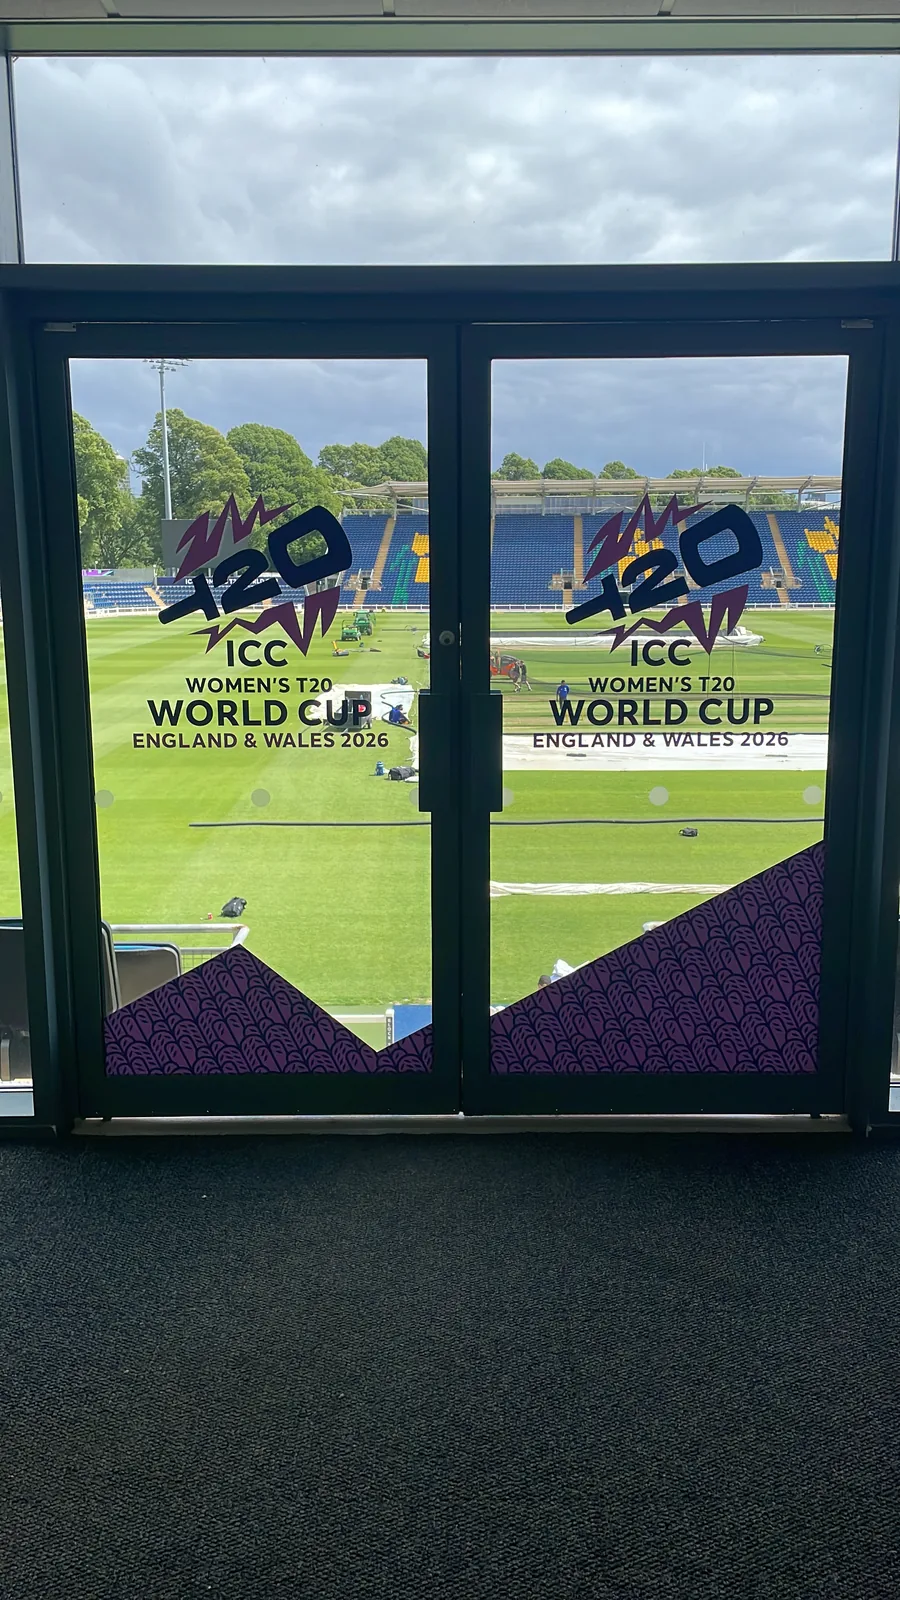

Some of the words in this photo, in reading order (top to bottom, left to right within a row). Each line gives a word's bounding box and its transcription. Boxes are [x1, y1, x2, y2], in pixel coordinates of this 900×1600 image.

[158, 505, 353, 624] T20
[565, 504, 763, 624] T20
[226, 640, 289, 667] ICC
[630, 639, 692, 667] ICC
[185, 677, 290, 693] WOMEN'S
[295, 677, 333, 693] T20
[588, 676, 692, 693] WOMEN'S
[698, 676, 736, 693] T20
[147, 699, 288, 727] WORLD
[298, 699, 373, 726] CUP
[549, 698, 688, 726] WORLD
[698, 697, 775, 725] CUP
[132, 732, 238, 749] ENGLAND
[244, 732, 258, 748] &
[263, 732, 335, 748] WALES
[340, 732, 389, 748] 2026
[533, 732, 636, 748] ENGLAND
[642, 732, 656, 748] &
[661, 731, 734, 747] WALES
[740, 731, 789, 747] 2026
